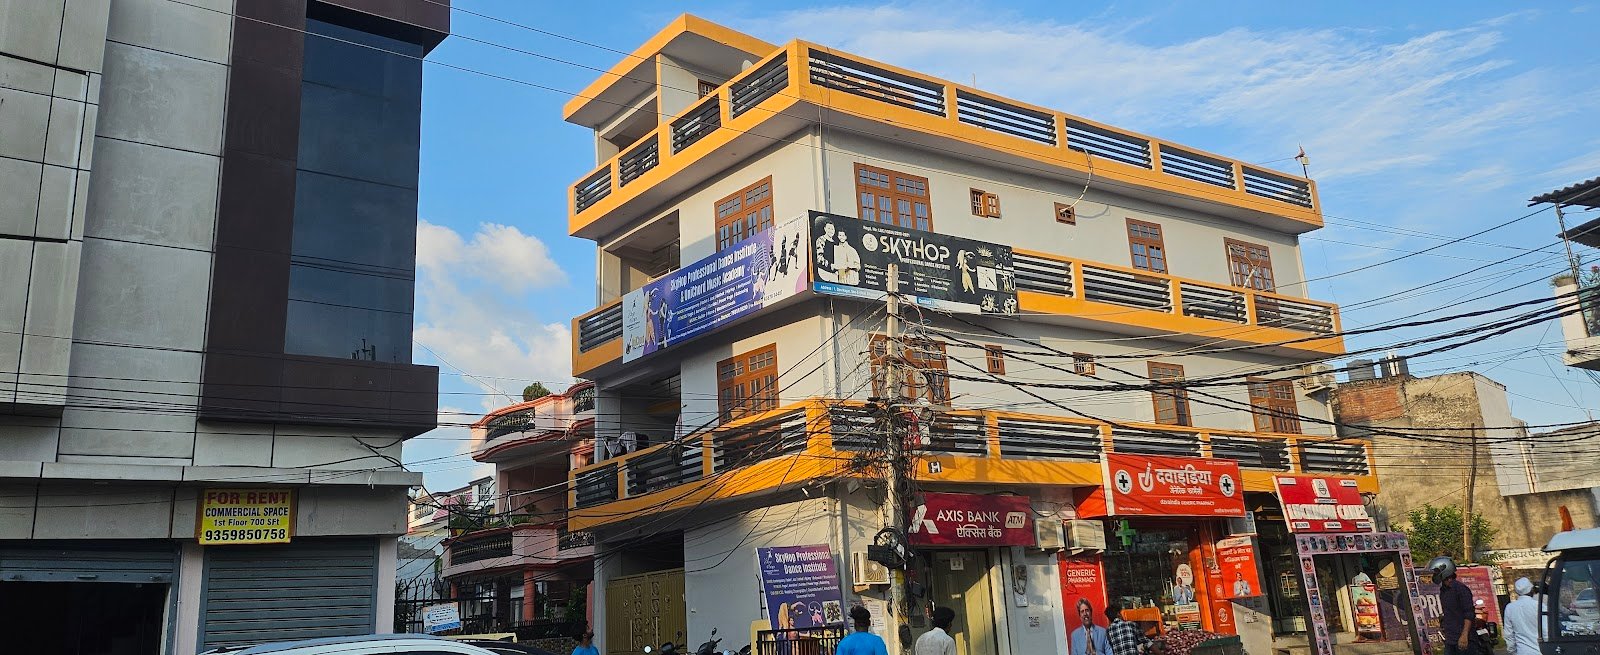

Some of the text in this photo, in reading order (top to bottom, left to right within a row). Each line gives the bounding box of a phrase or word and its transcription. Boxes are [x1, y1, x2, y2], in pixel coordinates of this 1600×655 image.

[880, 236, 950, 263] SKYHOP
[670, 243, 756, 292] SkyHop Professional Dance Institute
[680, 291, 684, 302] &
[706, 275, 722, 291] Music
[722, 265, 745, 285] Academy
[1155, 464, 1212, 486] दवाइंडिया
[207, 492, 288, 504] FOR RENT
[206, 507, 288, 517] COMMERCIAL SPACE
[936, 510, 1024, 524] AXIS BANK ATM
[206, 529, 286, 540] 9359850758
[988, 525, 1002, 538] बैंक
[775, 550, 830, 564] SkyHop Professional
[784, 564, 802, 574] Dance
[802, 562, 827, 572] Institute
